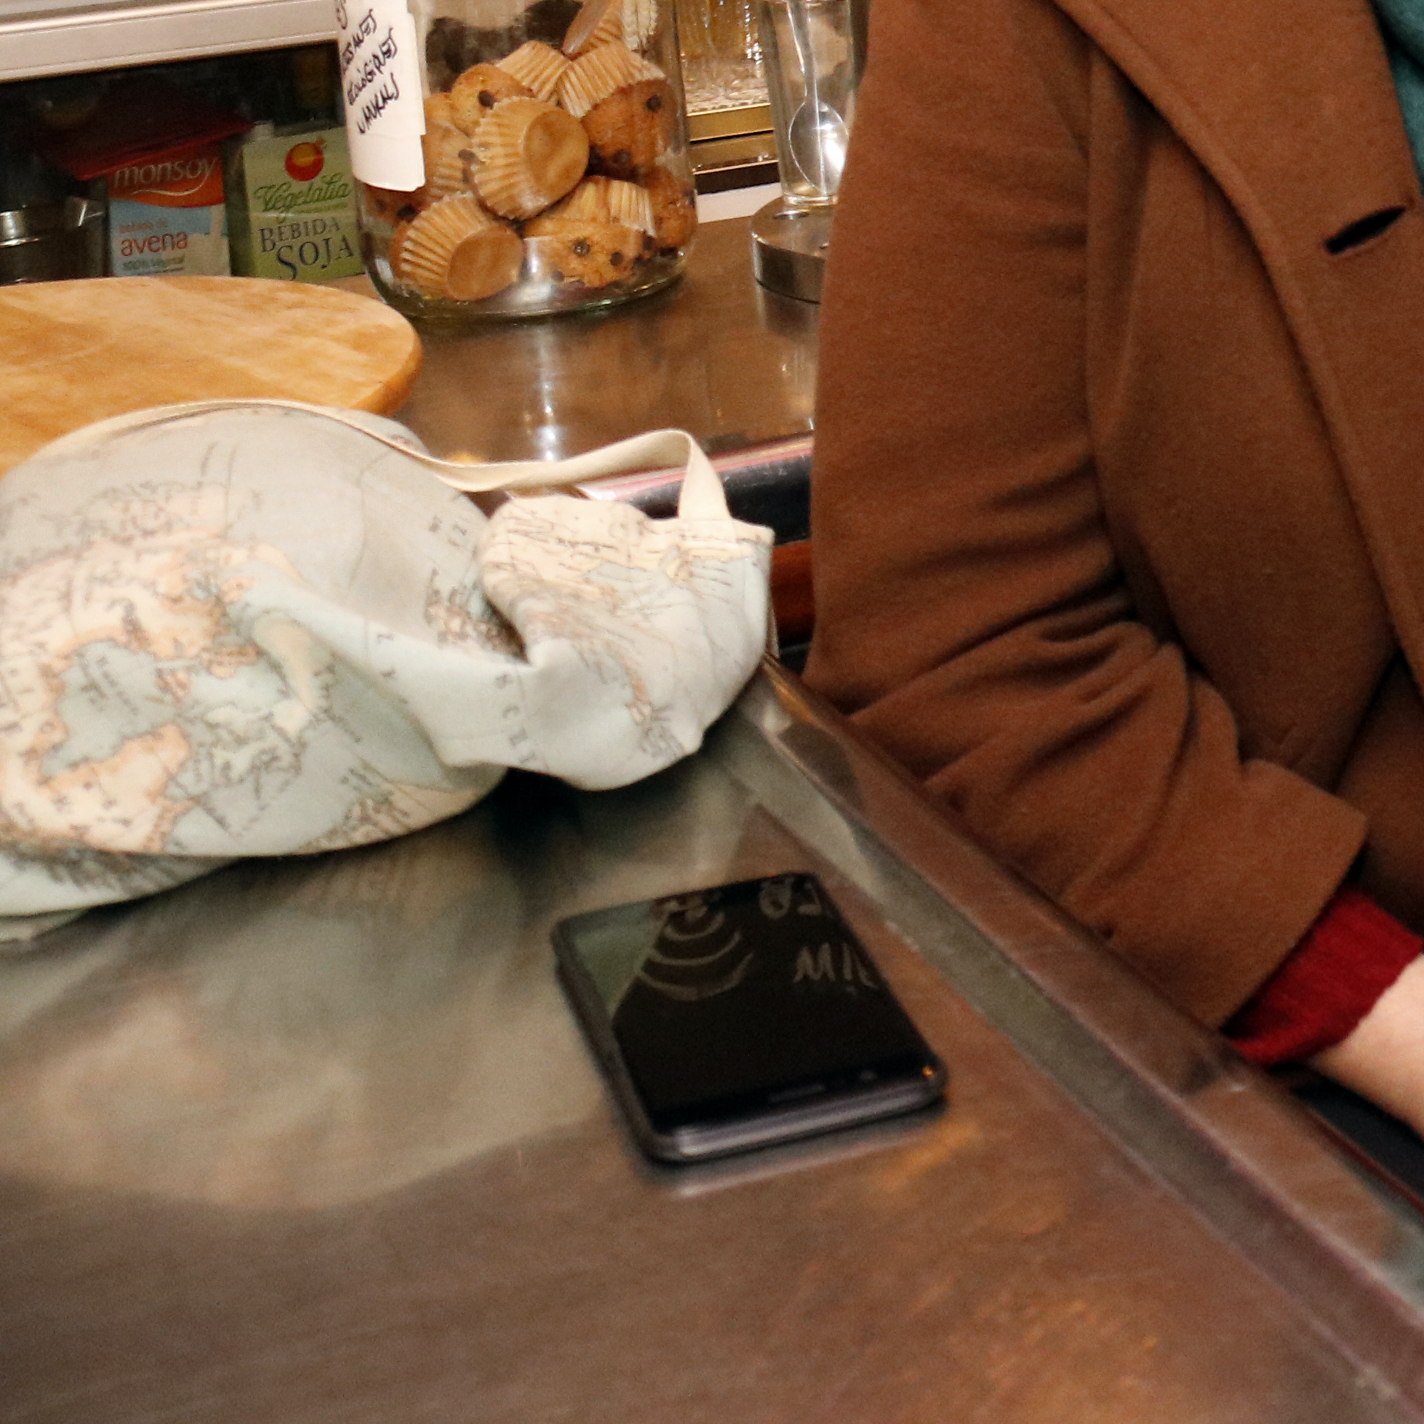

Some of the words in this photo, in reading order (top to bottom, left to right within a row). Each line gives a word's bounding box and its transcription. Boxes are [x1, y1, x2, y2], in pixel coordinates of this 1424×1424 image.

[114, 156, 217, 192] monsoy
[121, 231, 188, 257] avena
[258, 217, 340, 253] BEBIDA
[276, 235, 355, 281] SOJA
